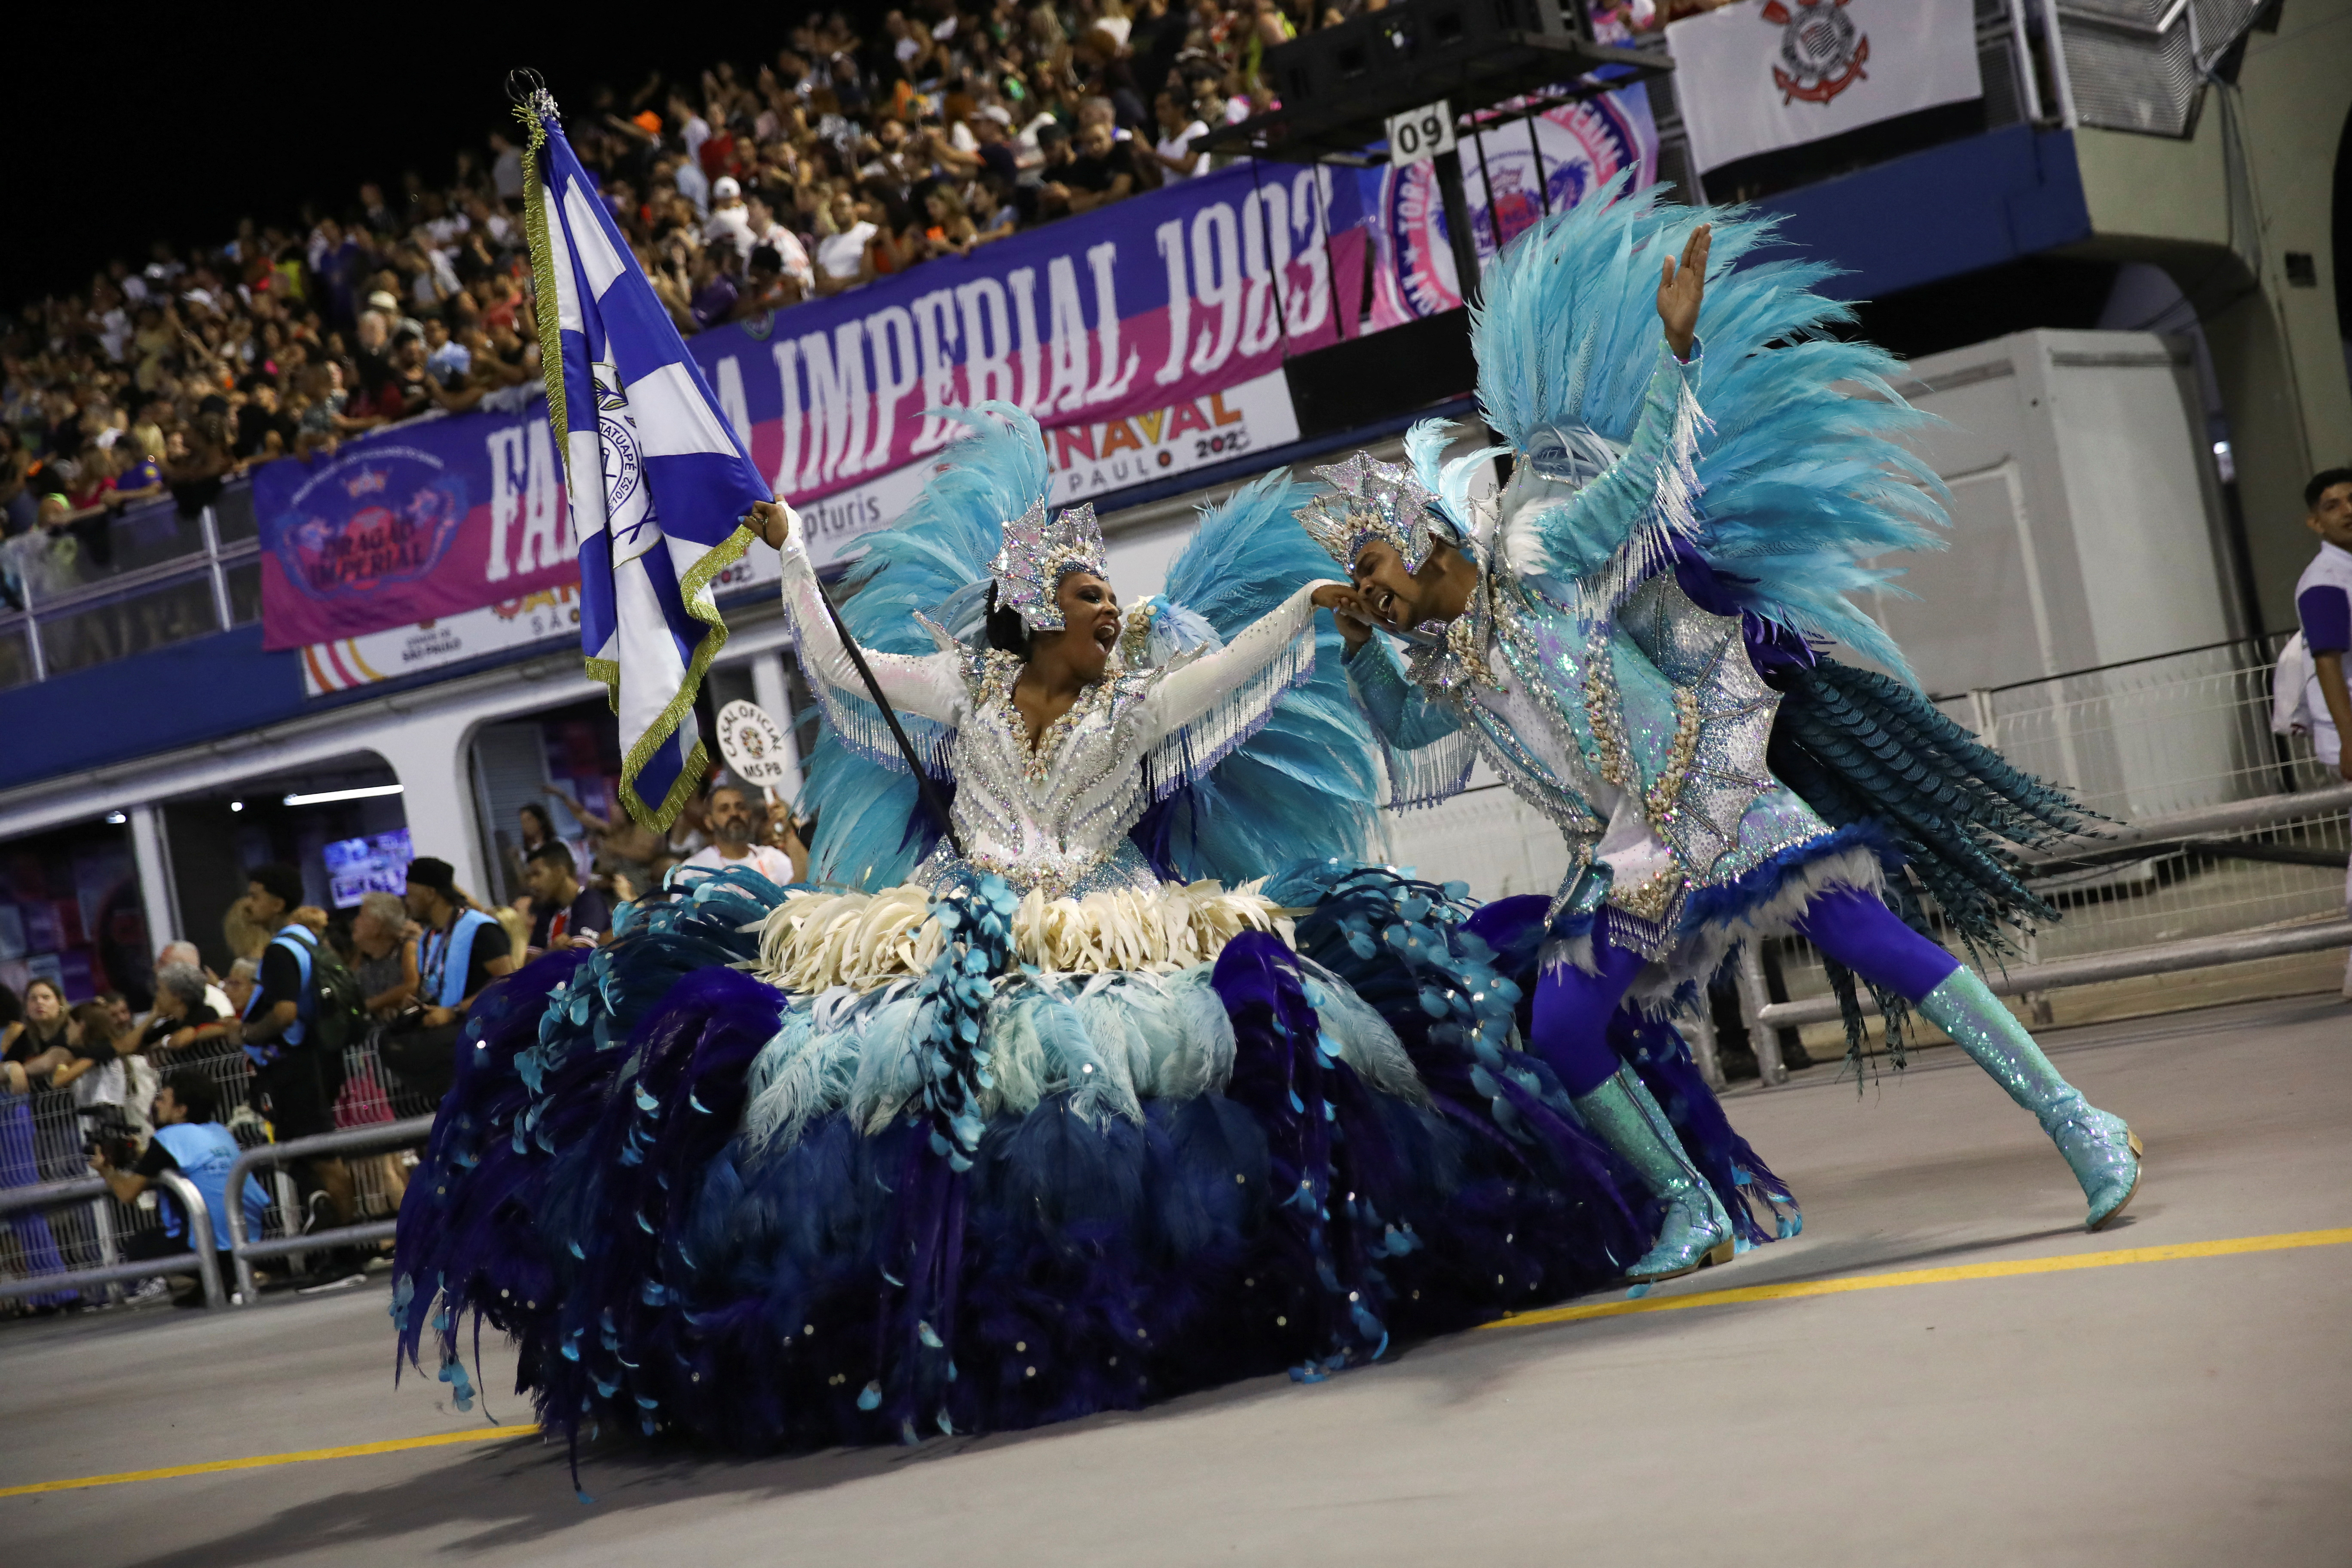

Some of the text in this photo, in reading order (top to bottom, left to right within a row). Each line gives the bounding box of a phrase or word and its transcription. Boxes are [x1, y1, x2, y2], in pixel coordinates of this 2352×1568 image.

[1398, 113, 1442, 154] 09
[772, 242, 1140, 497] IMPERIAL
[1155, 162, 1332, 386] 1983
[599, 421, 637, 472] TATUAPÉ
[1068, 450, 1173, 493] PAULO
[803, 493, 881, 545] pturis
[721, 705, 783, 757] CASAL OFICIAL
